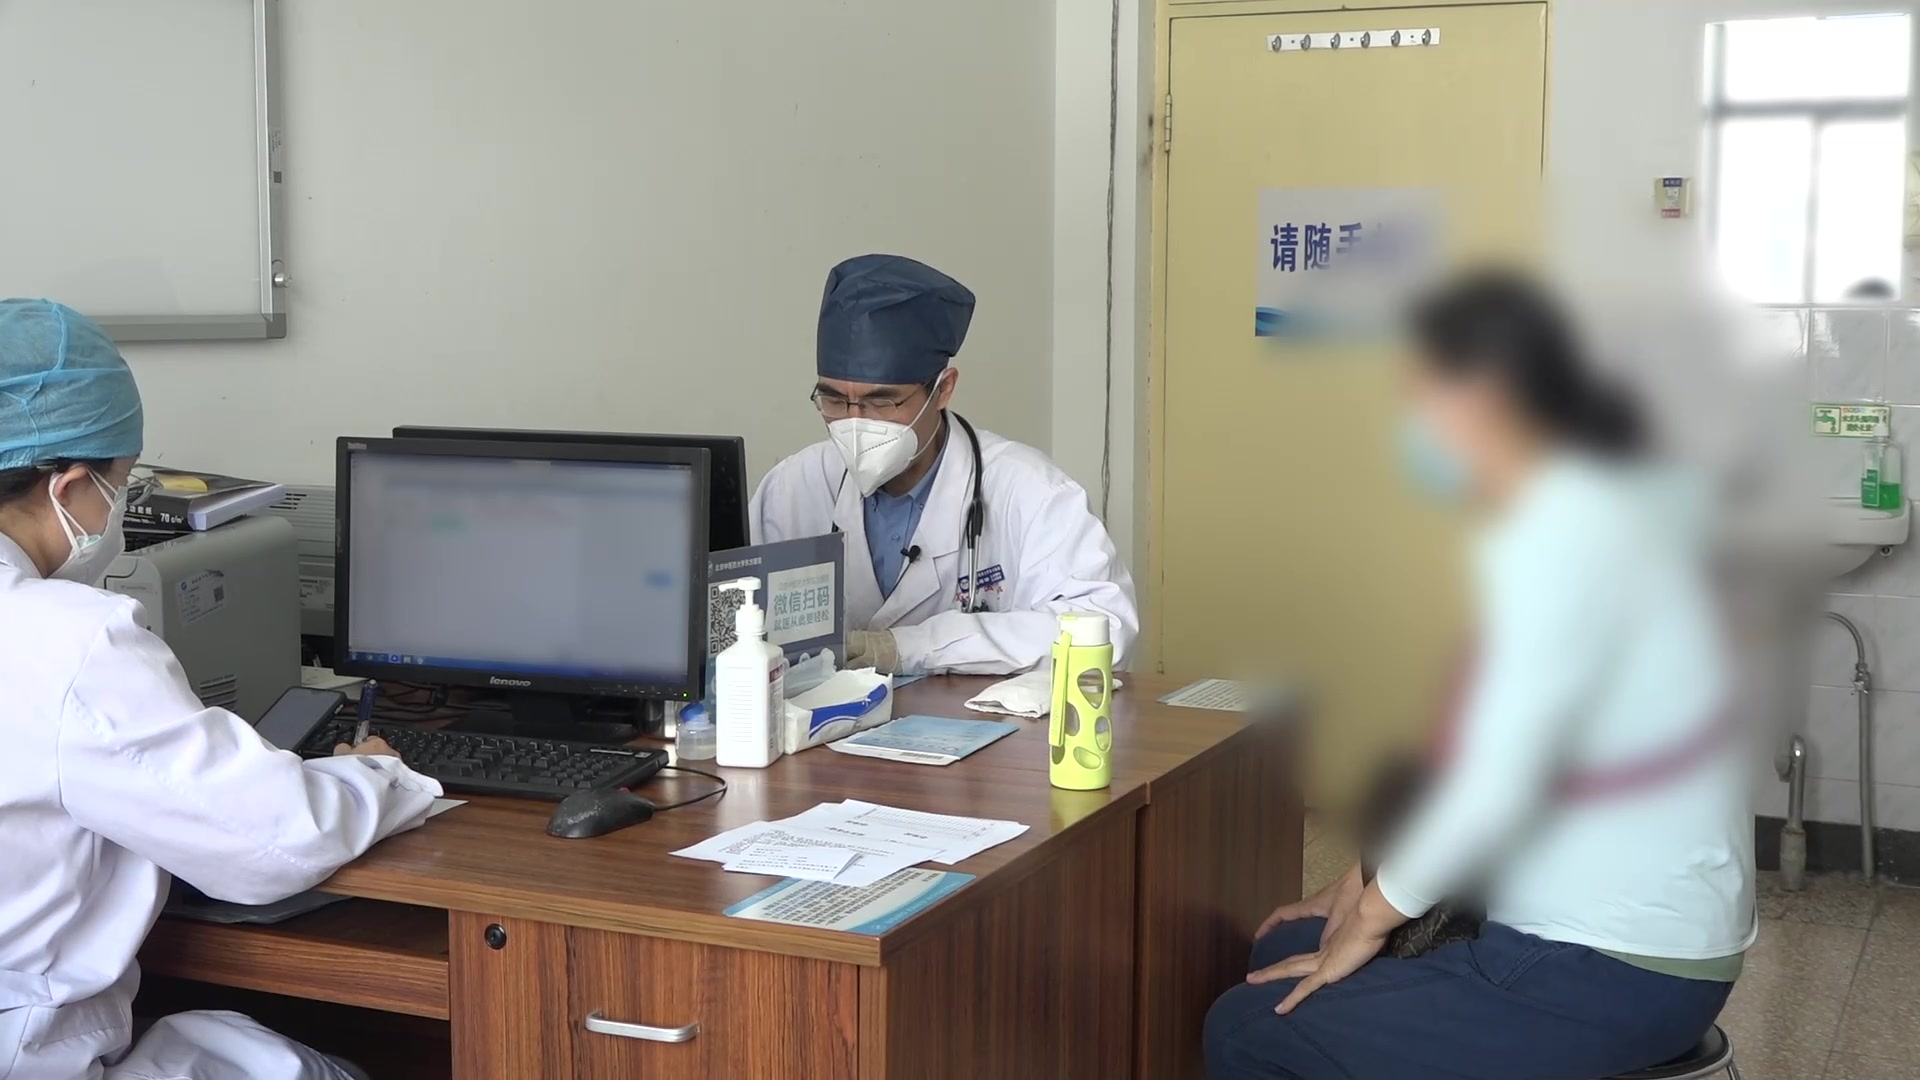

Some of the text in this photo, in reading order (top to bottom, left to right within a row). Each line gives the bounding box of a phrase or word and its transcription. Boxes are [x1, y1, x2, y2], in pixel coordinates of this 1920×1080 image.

[125, 505, 153, 515] 功能纸
[774, 585, 830, 616] 微信扫码
[774, 609, 830, 631] 就医从此更轻松
[490, 676, 531, 687] lenovo
